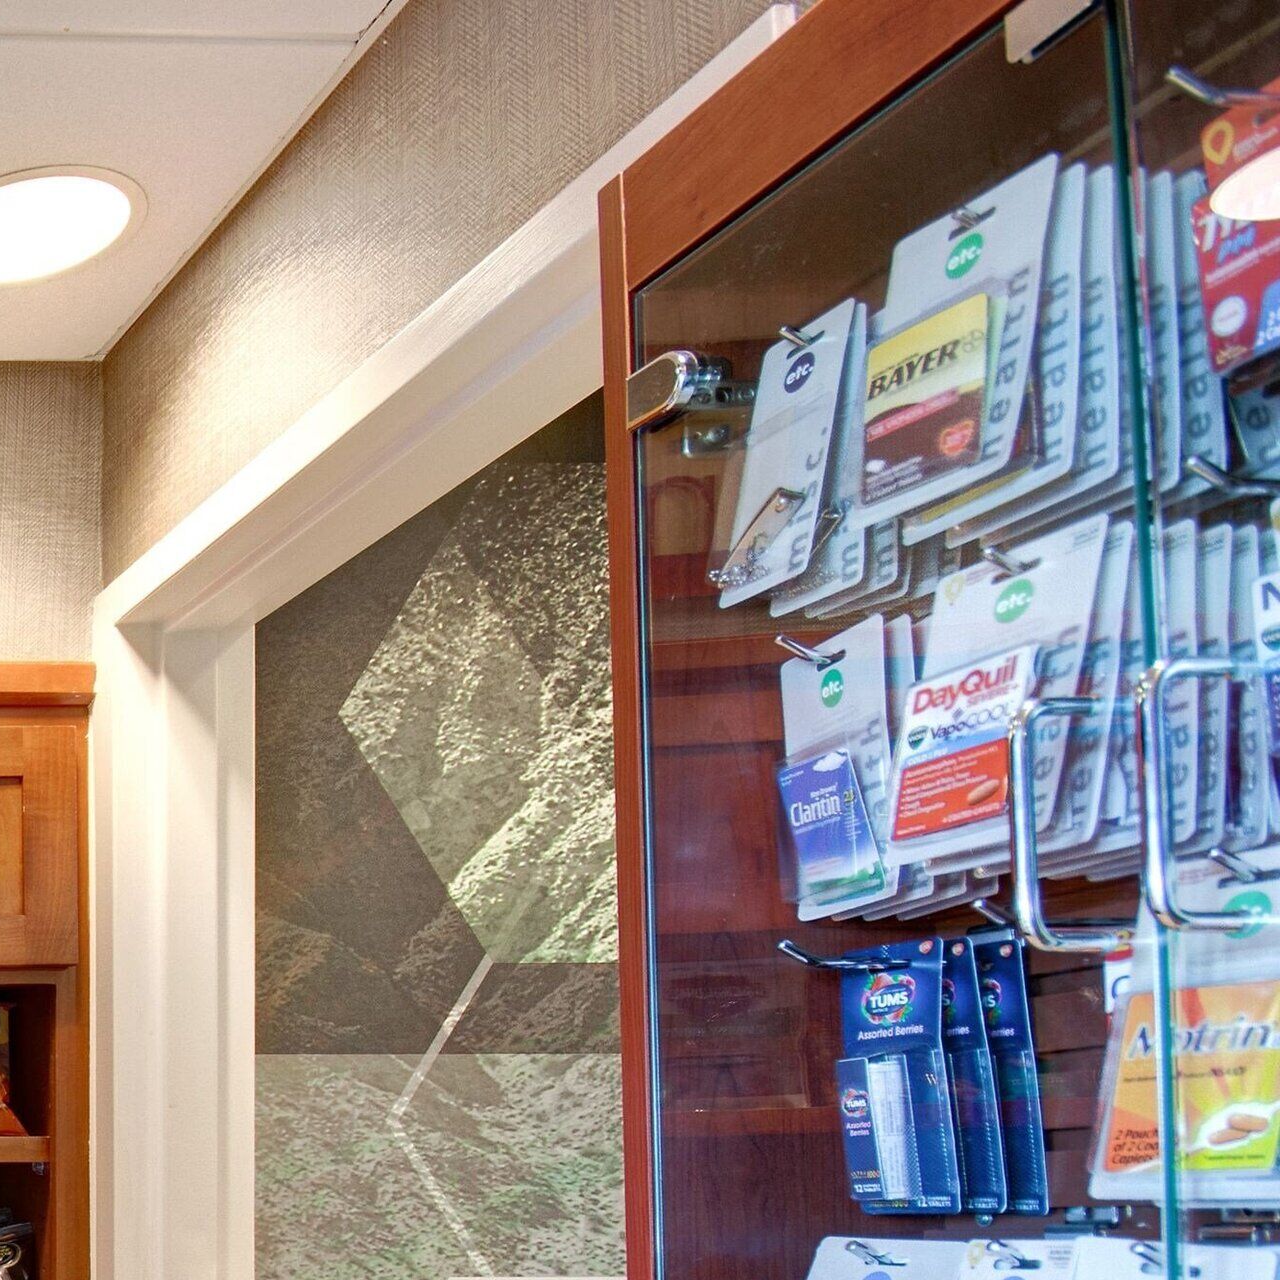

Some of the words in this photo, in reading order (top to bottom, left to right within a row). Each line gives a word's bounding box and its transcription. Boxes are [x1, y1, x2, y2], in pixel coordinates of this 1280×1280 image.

[949, 247, 982, 269] etc.
[785, 363, 814, 383] etc.
[869, 338, 962, 399] BAYER
[996, 593, 1032, 615] etc.
[822, 678, 843, 695] etc.
[912, 655, 1019, 715] DayQuil
[791, 794, 841, 826] Claritin
[870, 992, 909, 1008] TUMS
[858, 1028, 893, 1041] Assorted
[895, 1025, 924, 1036] Berries
[847, 1099, 866, 1108] TUMS
[846, 1121, 871, 1130] Assorted
